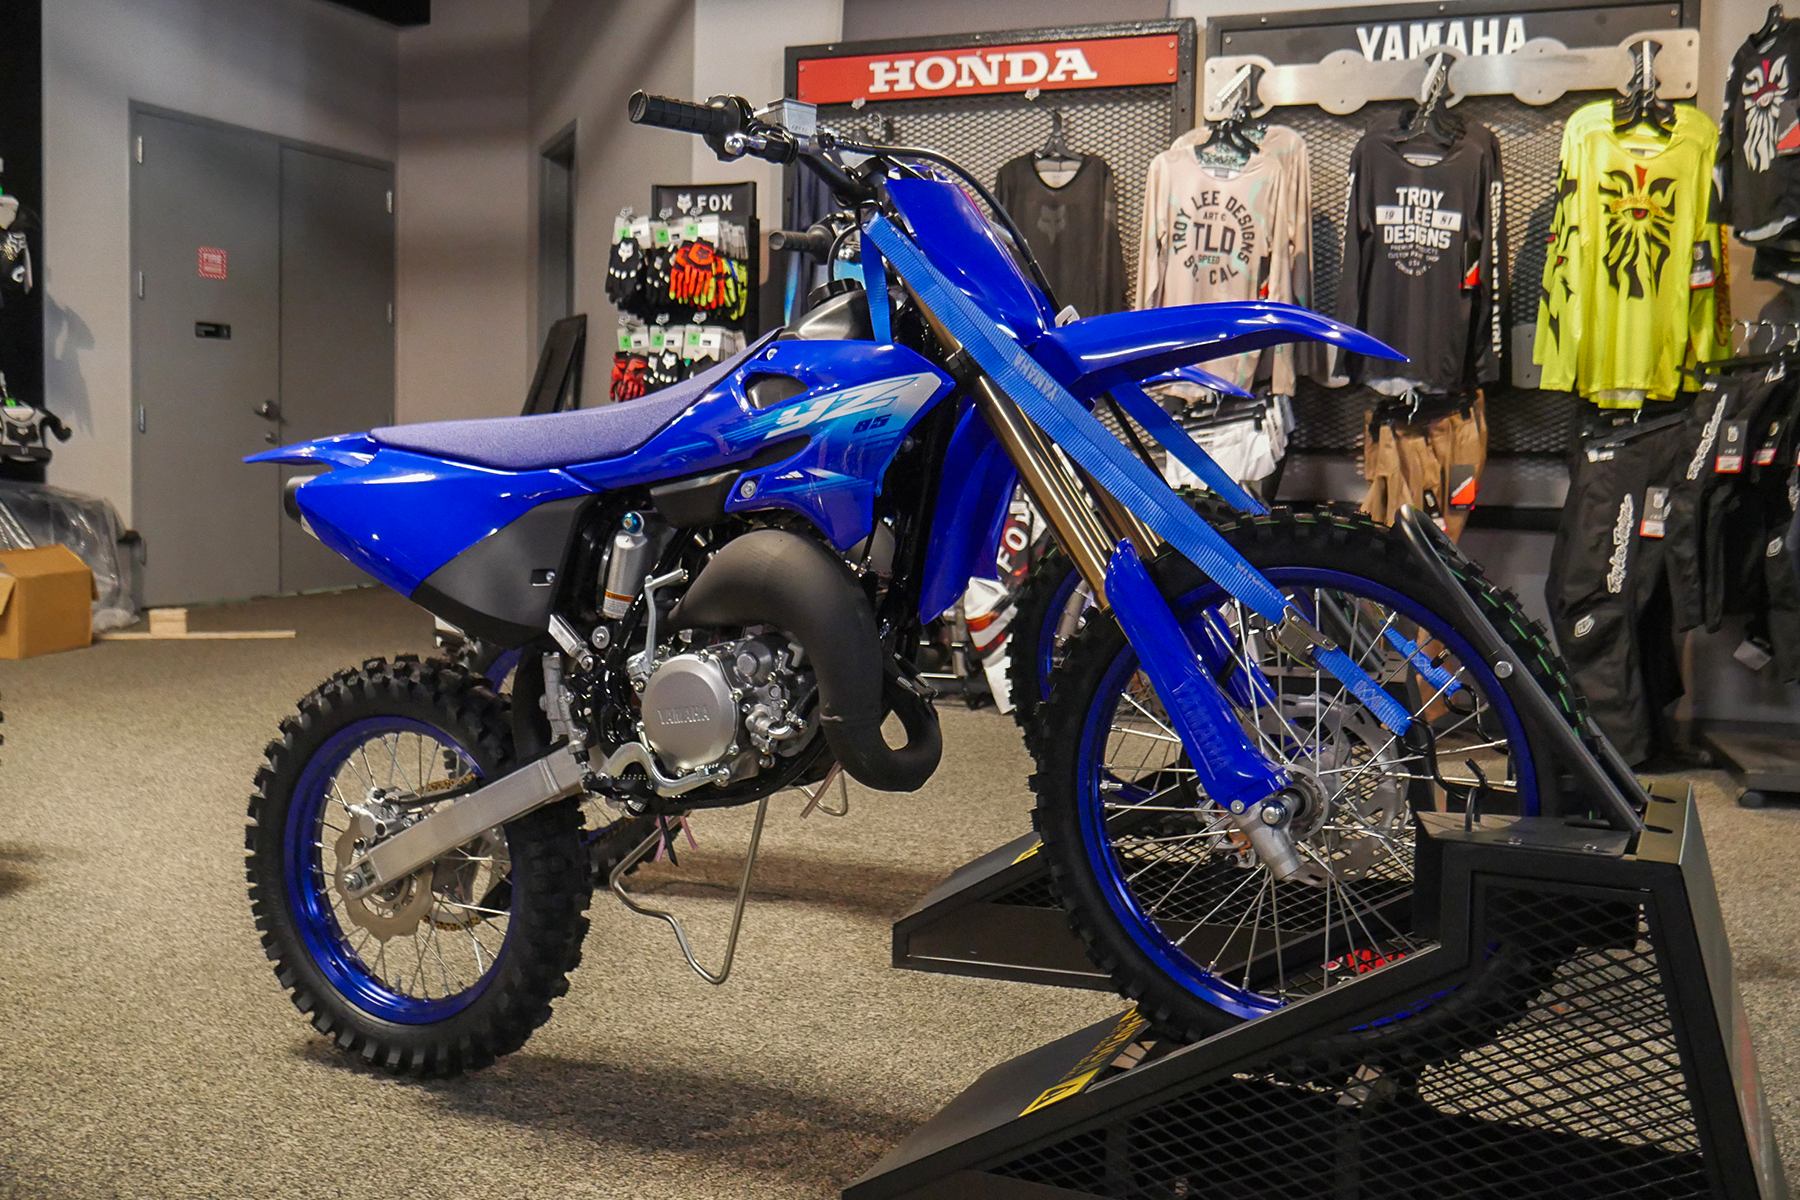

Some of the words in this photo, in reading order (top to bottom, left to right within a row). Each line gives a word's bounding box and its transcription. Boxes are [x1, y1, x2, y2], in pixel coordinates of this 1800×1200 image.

[1356, 16, 1527, 62] YAMAHA
[868, 48, 1098, 93] HONDA
[697, 194, 733, 212] FOX
[1395, 186, 1444, 210] TROY
[1172, 207, 1192, 255] TROY
[1191, 190, 1220, 210] LEE
[1225, 196, 1255, 265] DESIGNS
[1202, 212, 1219, 222] ART
[1384, 209, 1395, 220] 19
[1404, 206, 1432, 228] LEE
[1440, 214, 1453, 226] 81
[1193, 221, 1236, 255] TLD
[1384, 225, 1452, 250] DESIGNS
[1198, 255, 1221, 264] SPEED
[1209, 264, 1239, 285] CAL
[1013, 352, 1058, 401] YAMAHA
[763, 376, 918, 440] YZ
[852, 414, 892, 434] 85
[1609, 545, 1627, 570] Lee
[1607, 565, 1627, 593] Troy
[1171, 677, 1234, 772] YAMAHA
